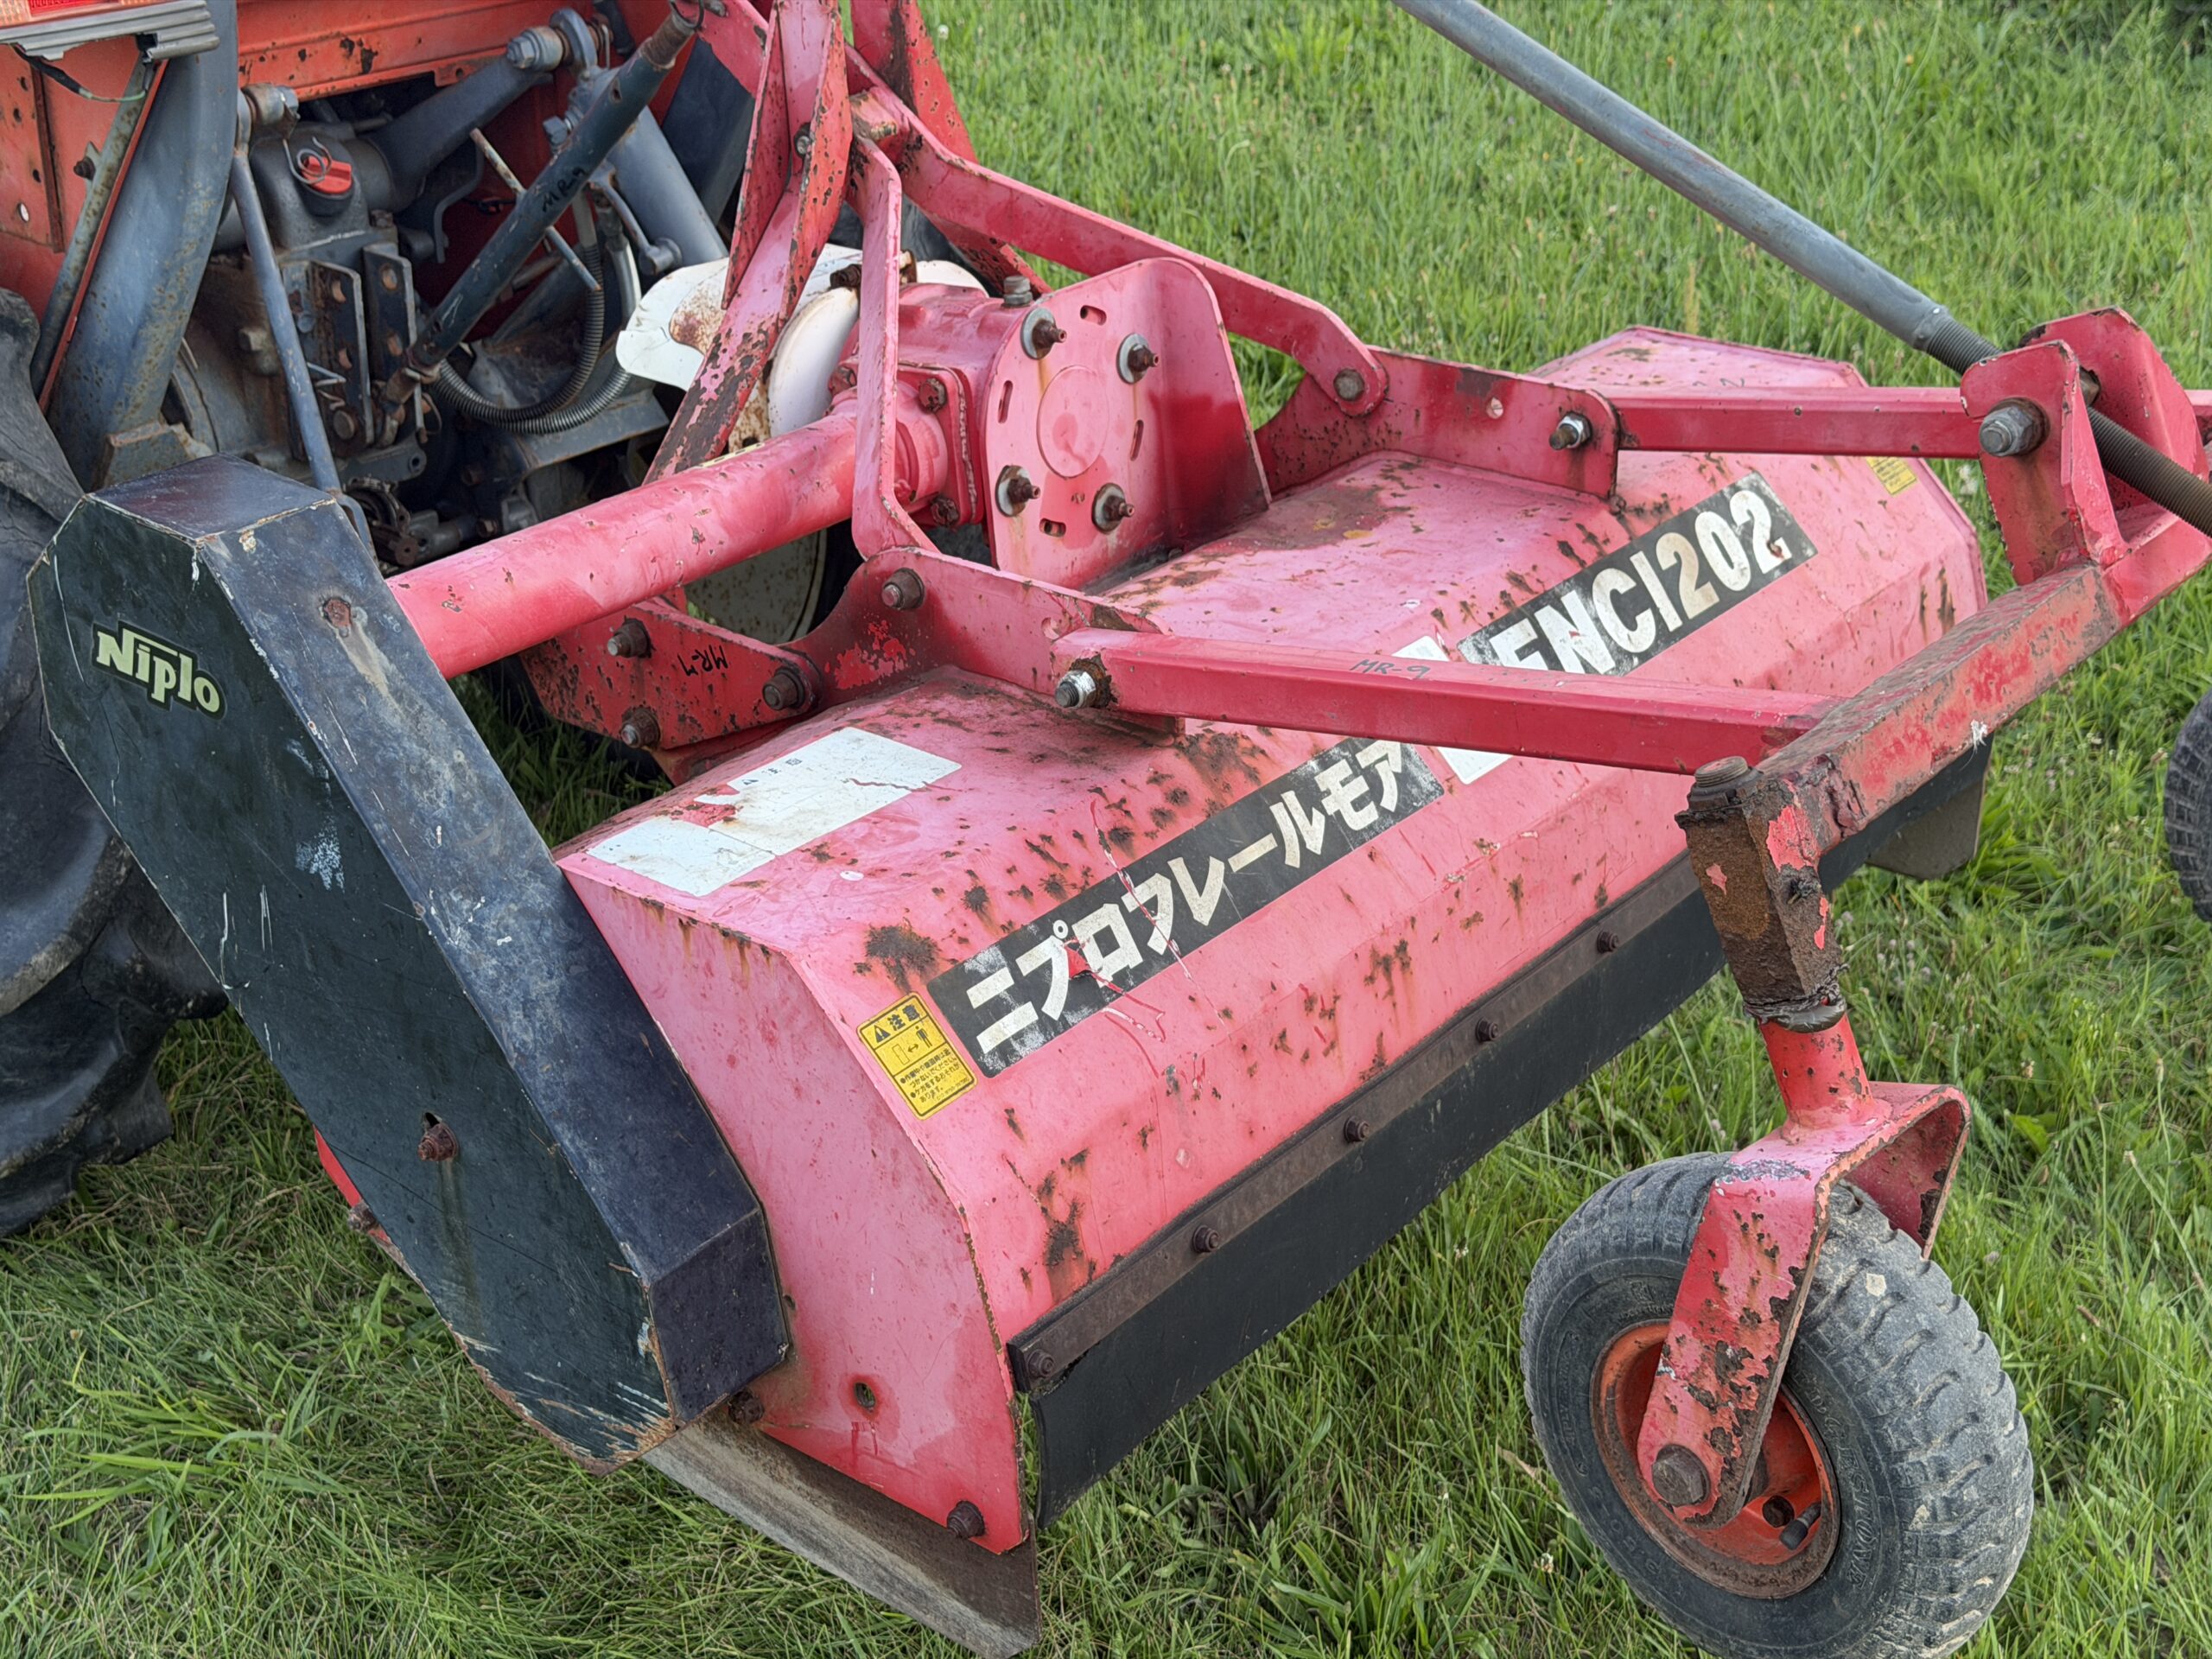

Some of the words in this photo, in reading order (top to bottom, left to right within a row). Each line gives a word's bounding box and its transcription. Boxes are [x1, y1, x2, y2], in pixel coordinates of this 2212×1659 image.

[96, 627, 220, 713] Niplo
[1349, 658, 1431, 679] MR-9
[966, 741, 1402, 1054] ニプロフレールモア
[887, 1004, 921, 1032] 注意
